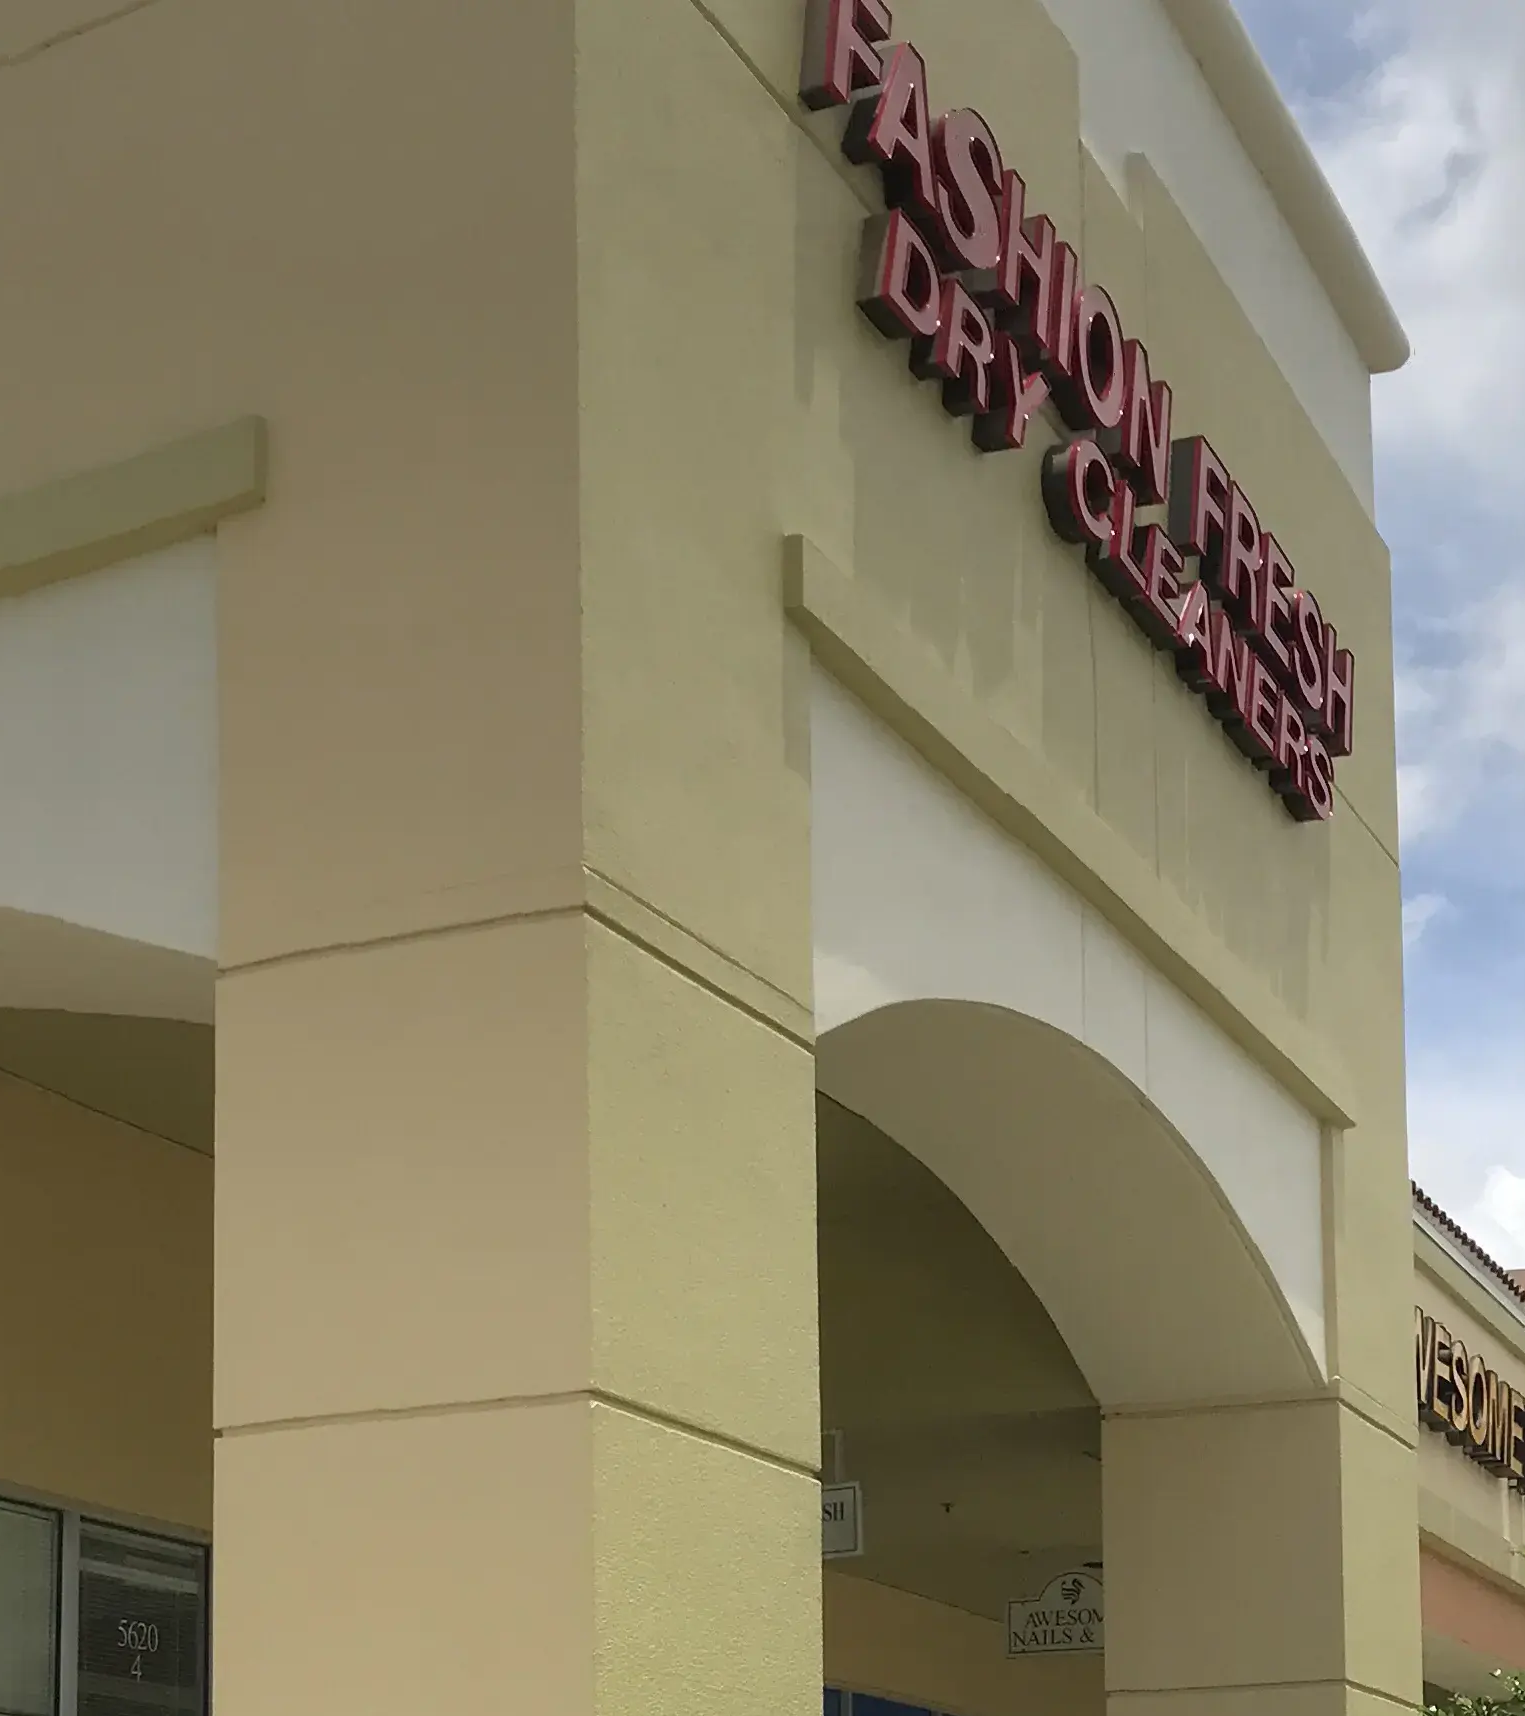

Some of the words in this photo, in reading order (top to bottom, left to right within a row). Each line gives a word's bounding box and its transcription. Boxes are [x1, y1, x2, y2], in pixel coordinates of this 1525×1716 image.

[803, 0, 1171, 504] FASHION
[1176, 436, 1354, 757] FRESH
[860, 209, 1051, 451] DRY
[1046, 440, 1335, 821] CLEANERS
[822, 1501, 845, 1523] SH
[1025, 1608, 1103, 1628] AWESOM
[118, 1619, 159, 1652] 5620
[1013, 1628, 1072, 1647] NAILS
[1079, 1627, 1095, 1643] &
[131, 1654, 142, 1682] 4
